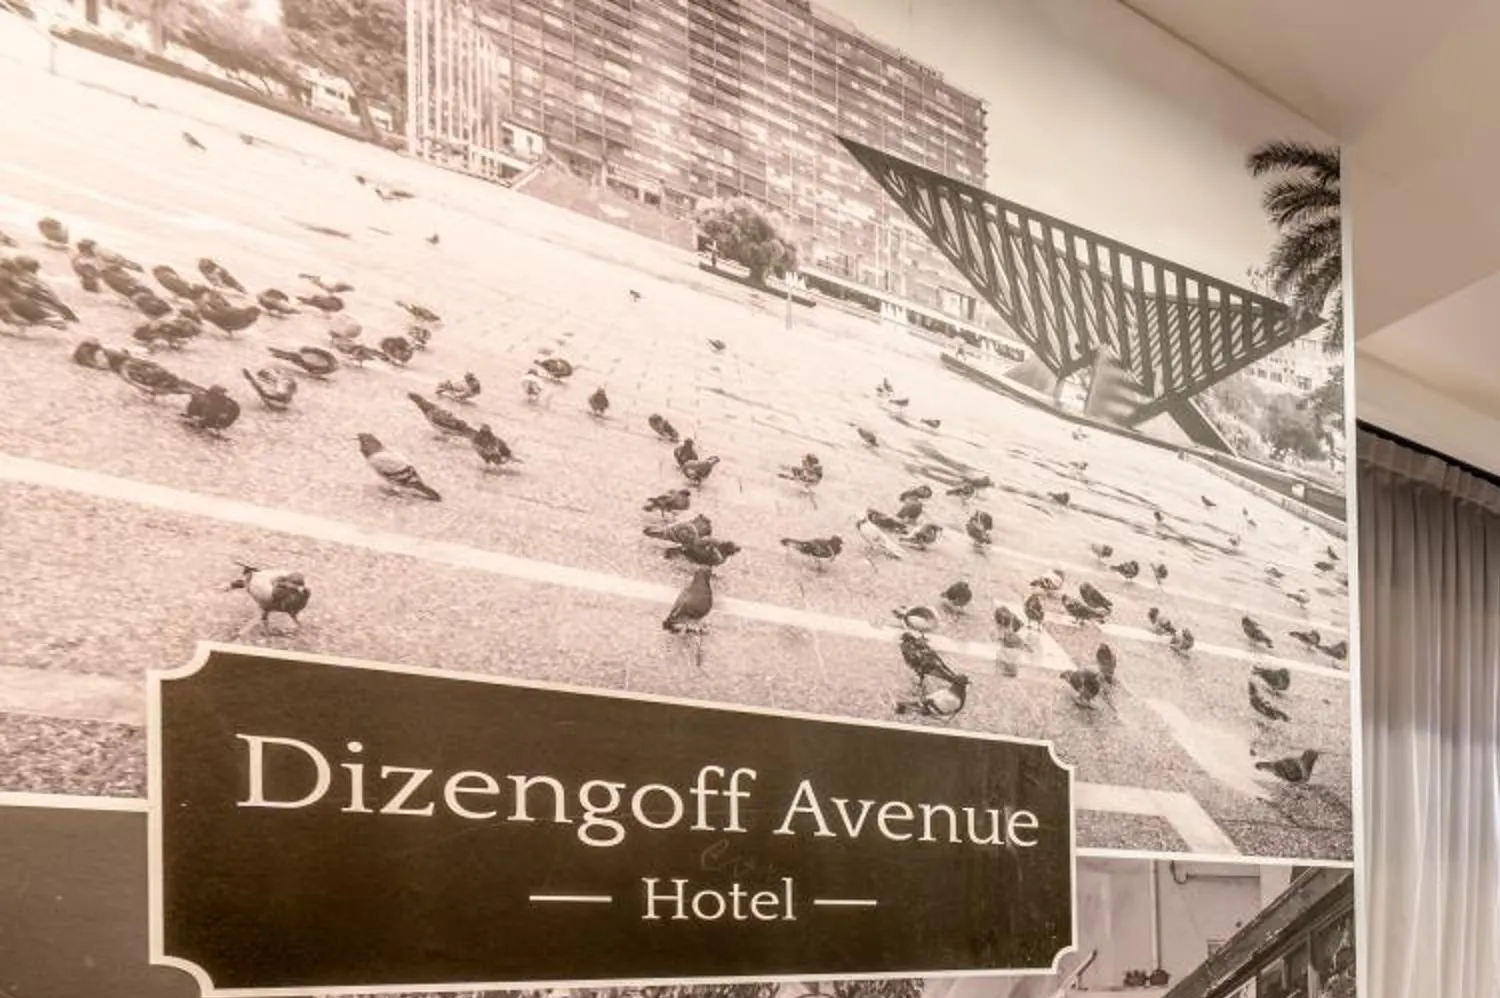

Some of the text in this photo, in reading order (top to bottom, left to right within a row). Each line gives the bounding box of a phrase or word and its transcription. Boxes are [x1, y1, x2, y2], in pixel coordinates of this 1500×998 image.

[235, 733, 1040, 848] Dizengoff Avenue
[641, 877, 797, 921] Hotel
